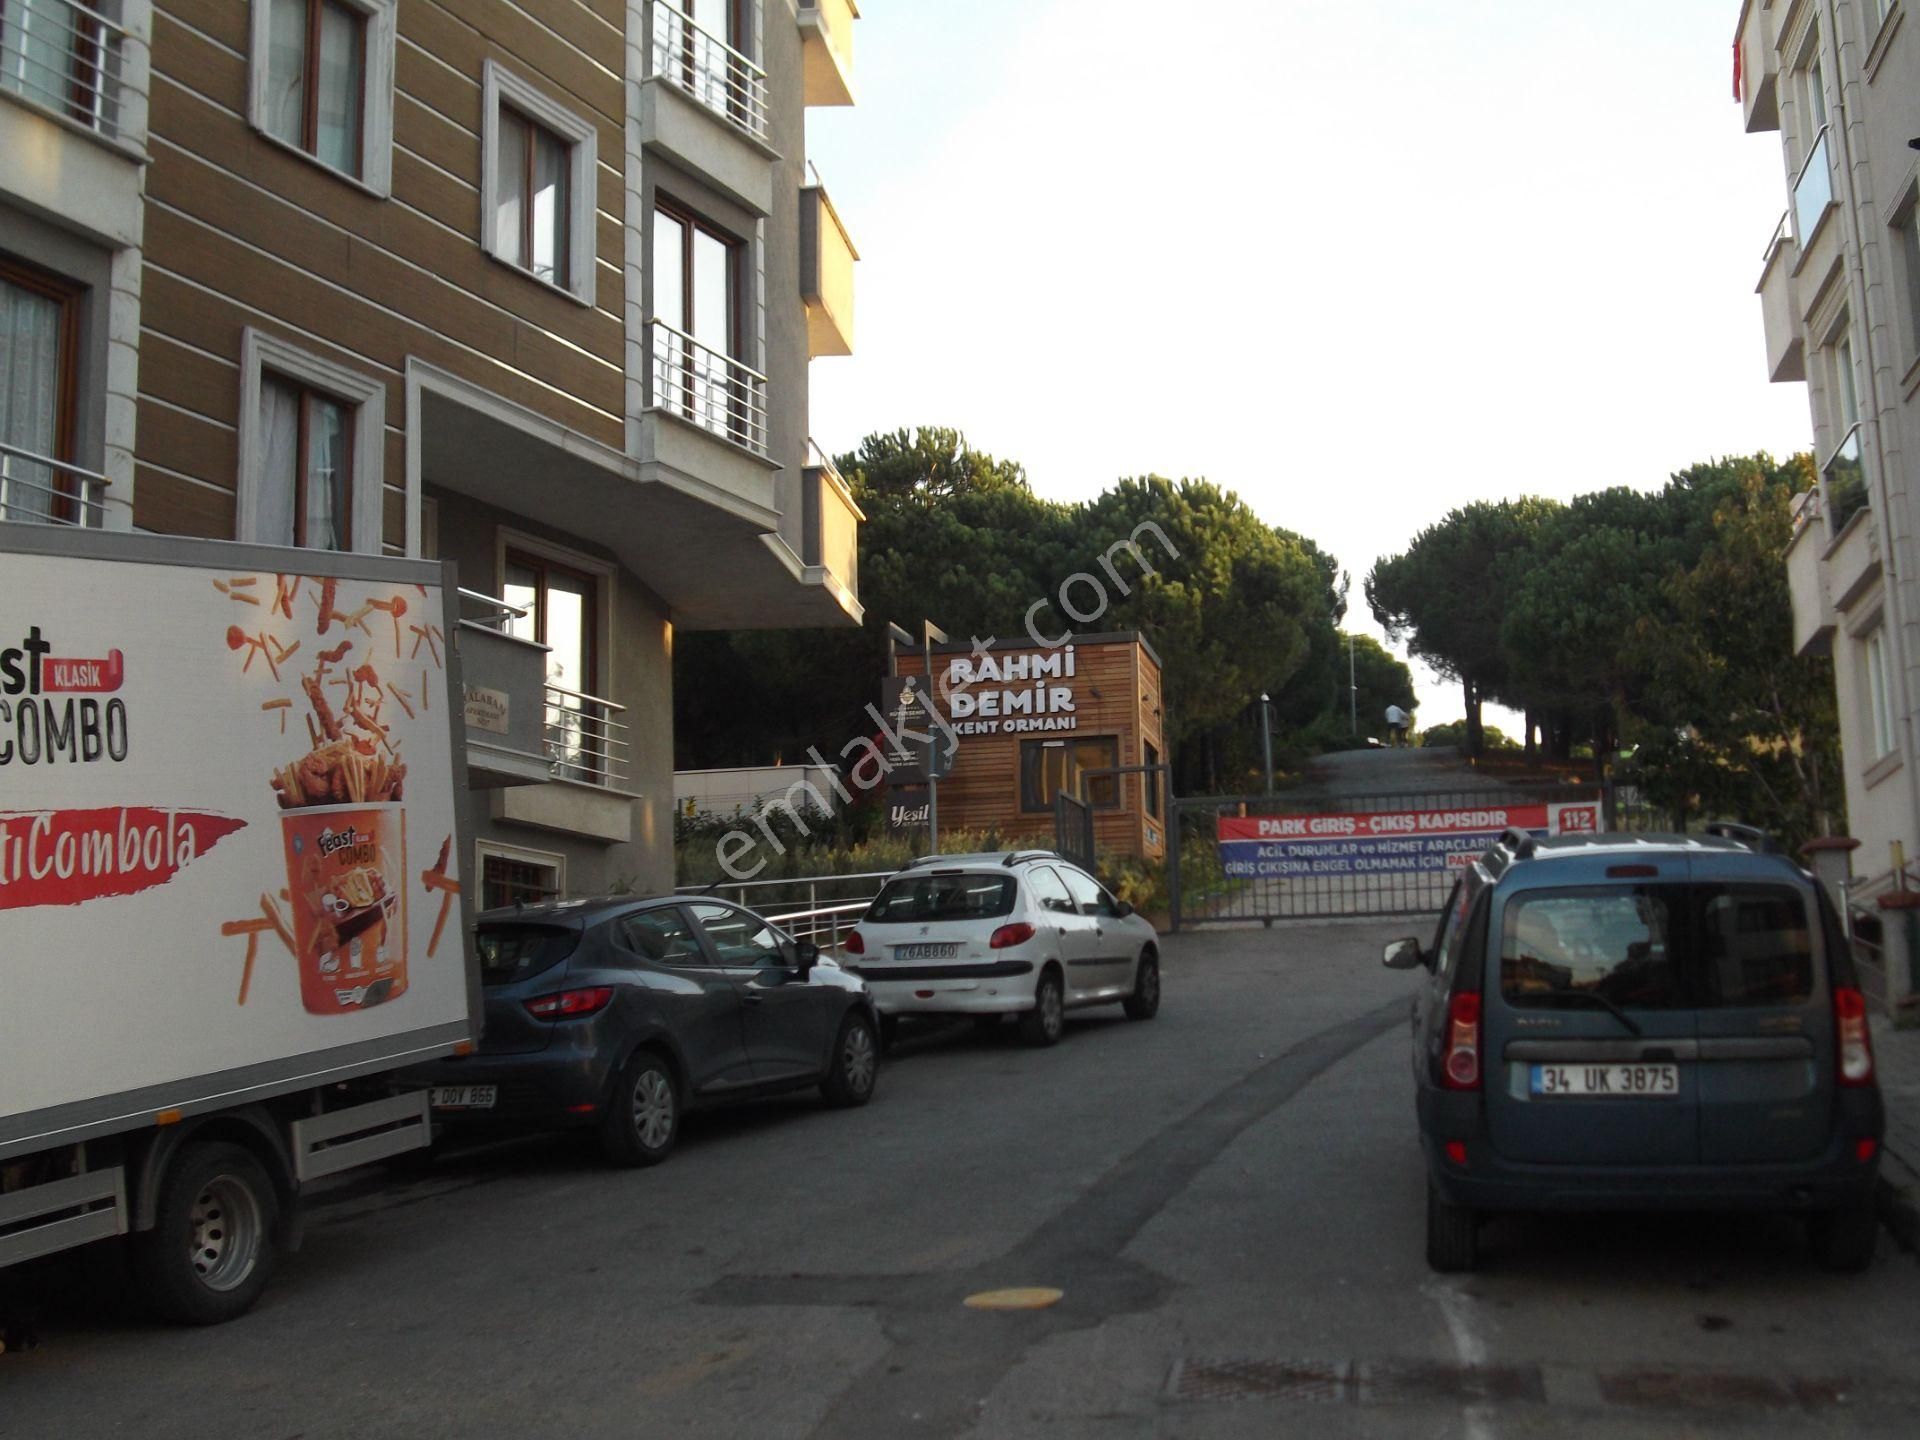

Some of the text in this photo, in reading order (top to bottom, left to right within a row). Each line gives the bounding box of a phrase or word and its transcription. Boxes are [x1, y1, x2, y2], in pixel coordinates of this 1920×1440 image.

[0, 626, 101, 695] st KLASİK
[950, 645, 1075, 684] RAHMİ
[950, 681, 1076, 718] DEMİR
[951, 717, 1076, 735] KENT ORMANI
[1258, 818, 1306, 835] PARK
[1369, 814, 1416, 834] ÇIKIŞ
[1419, 810, 1507, 830] KAPISIDIR
[1564, 811, 1591, 828] 112
[1257, 843, 1285, 857] ACİL
[1288, 843, 1357, 858] DURUMLAR
[1360, 845, 1376, 854] ve
[1377, 840, 1424, 853] HİZMET
[1225, 860, 1255, 874] GİRİŞ
[1257, 860, 1310, 874] ÇIKIŞINA
[1312, 859, 1352, 872] ENGEL
[1355, 857, 1416, 871] OLMAMAK
[1419, 854, 1443, 868] İÇİN
[1545, 1067, 1674, 1092] 34 UK 3875
